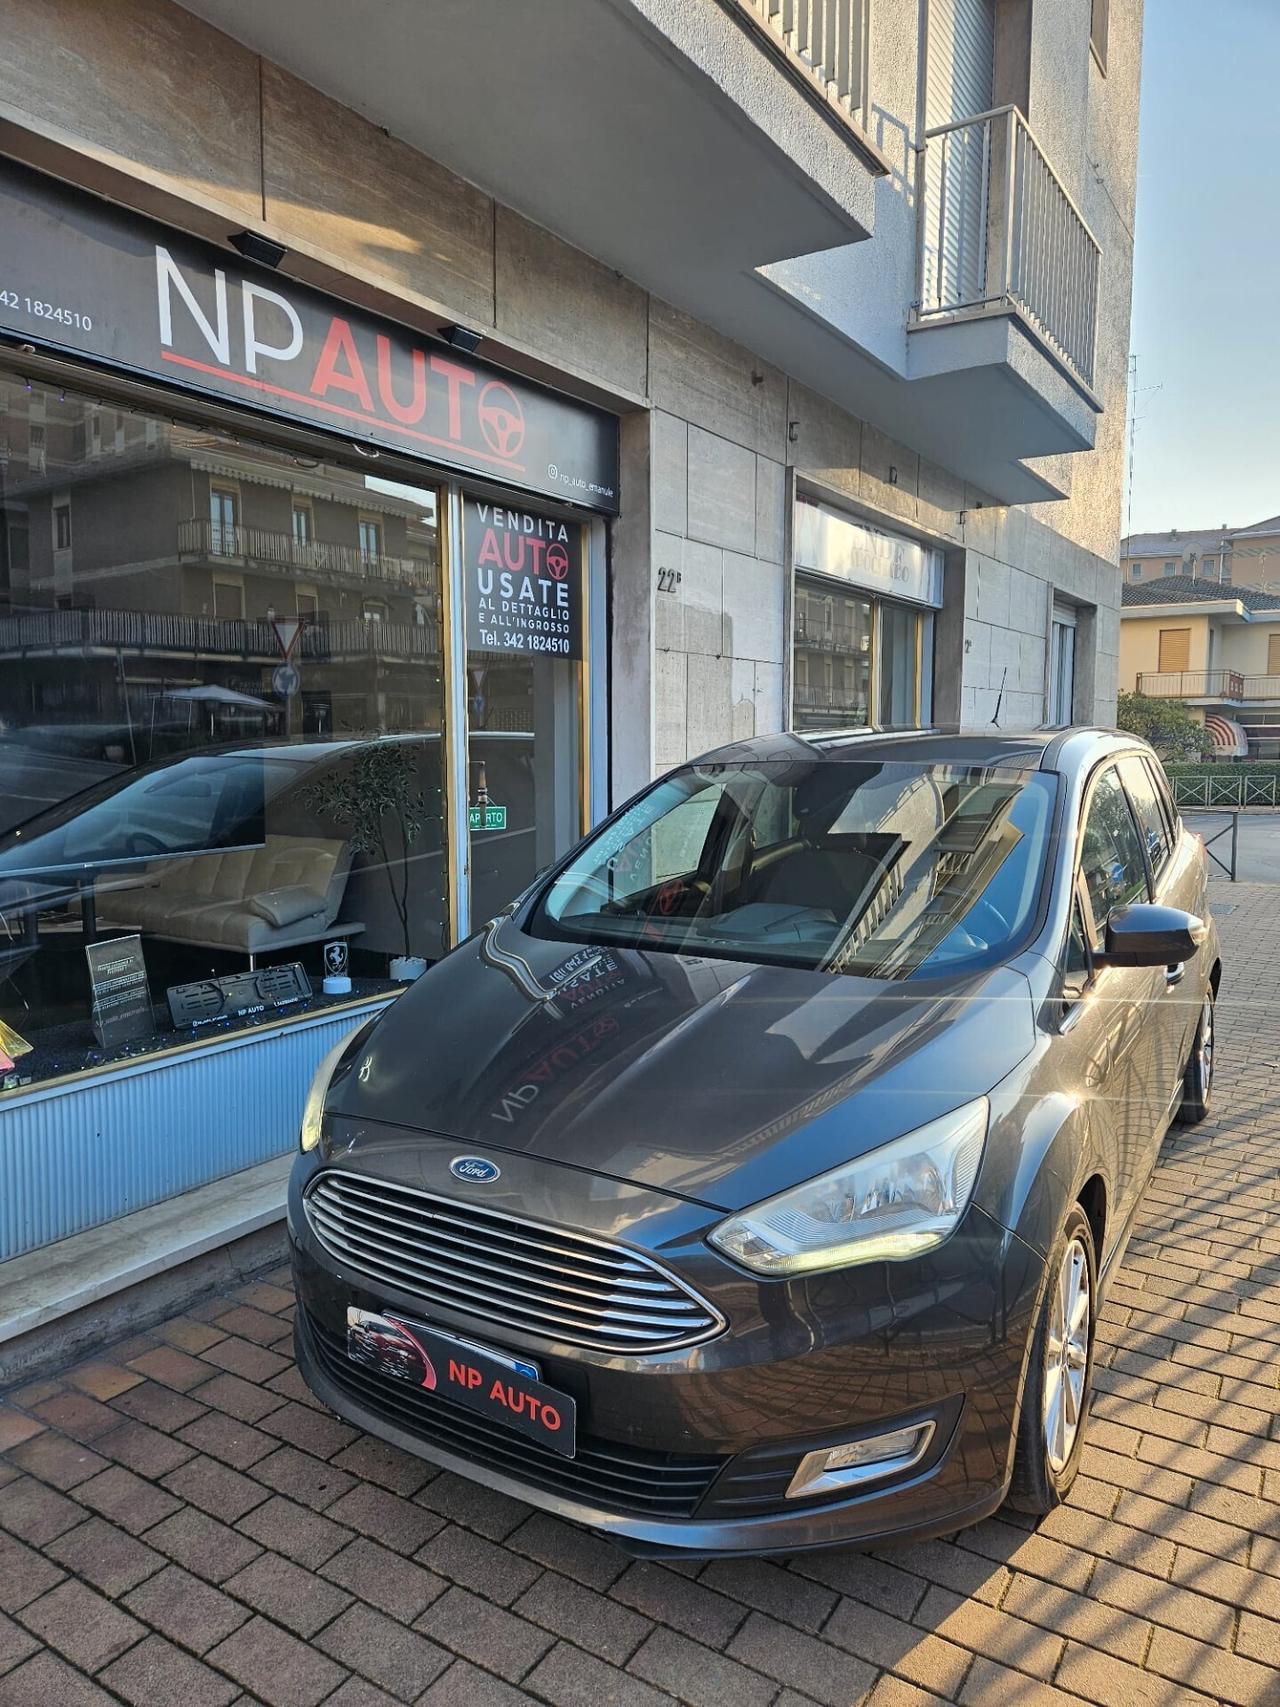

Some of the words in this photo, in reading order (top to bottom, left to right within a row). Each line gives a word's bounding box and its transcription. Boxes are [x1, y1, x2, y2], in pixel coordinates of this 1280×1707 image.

[24, 298, 92, 331] 1824510
[155, 245, 304, 374] NP
[476, 502, 569, 543] VENDITA
[477, 568, 569, 607] USATE
[479, 598, 495, 610] AL
[502, 601, 569, 620] DETTAGLIO
[479, 613, 485, 623] E
[491, 614, 569, 634] ALL'INGROSSO
[479, 629, 500, 646] Tel.
[503, 632, 524, 648] 342
[527, 634, 570, 653] 1824510
[470, 812, 503, 823] APRTO
[248, 1005, 265, 1015] AUTO
[459, 1160, 490, 1178] Ford
[449, 1359, 482, 1390] NP
[489, 1380, 561, 1431] AUTO
